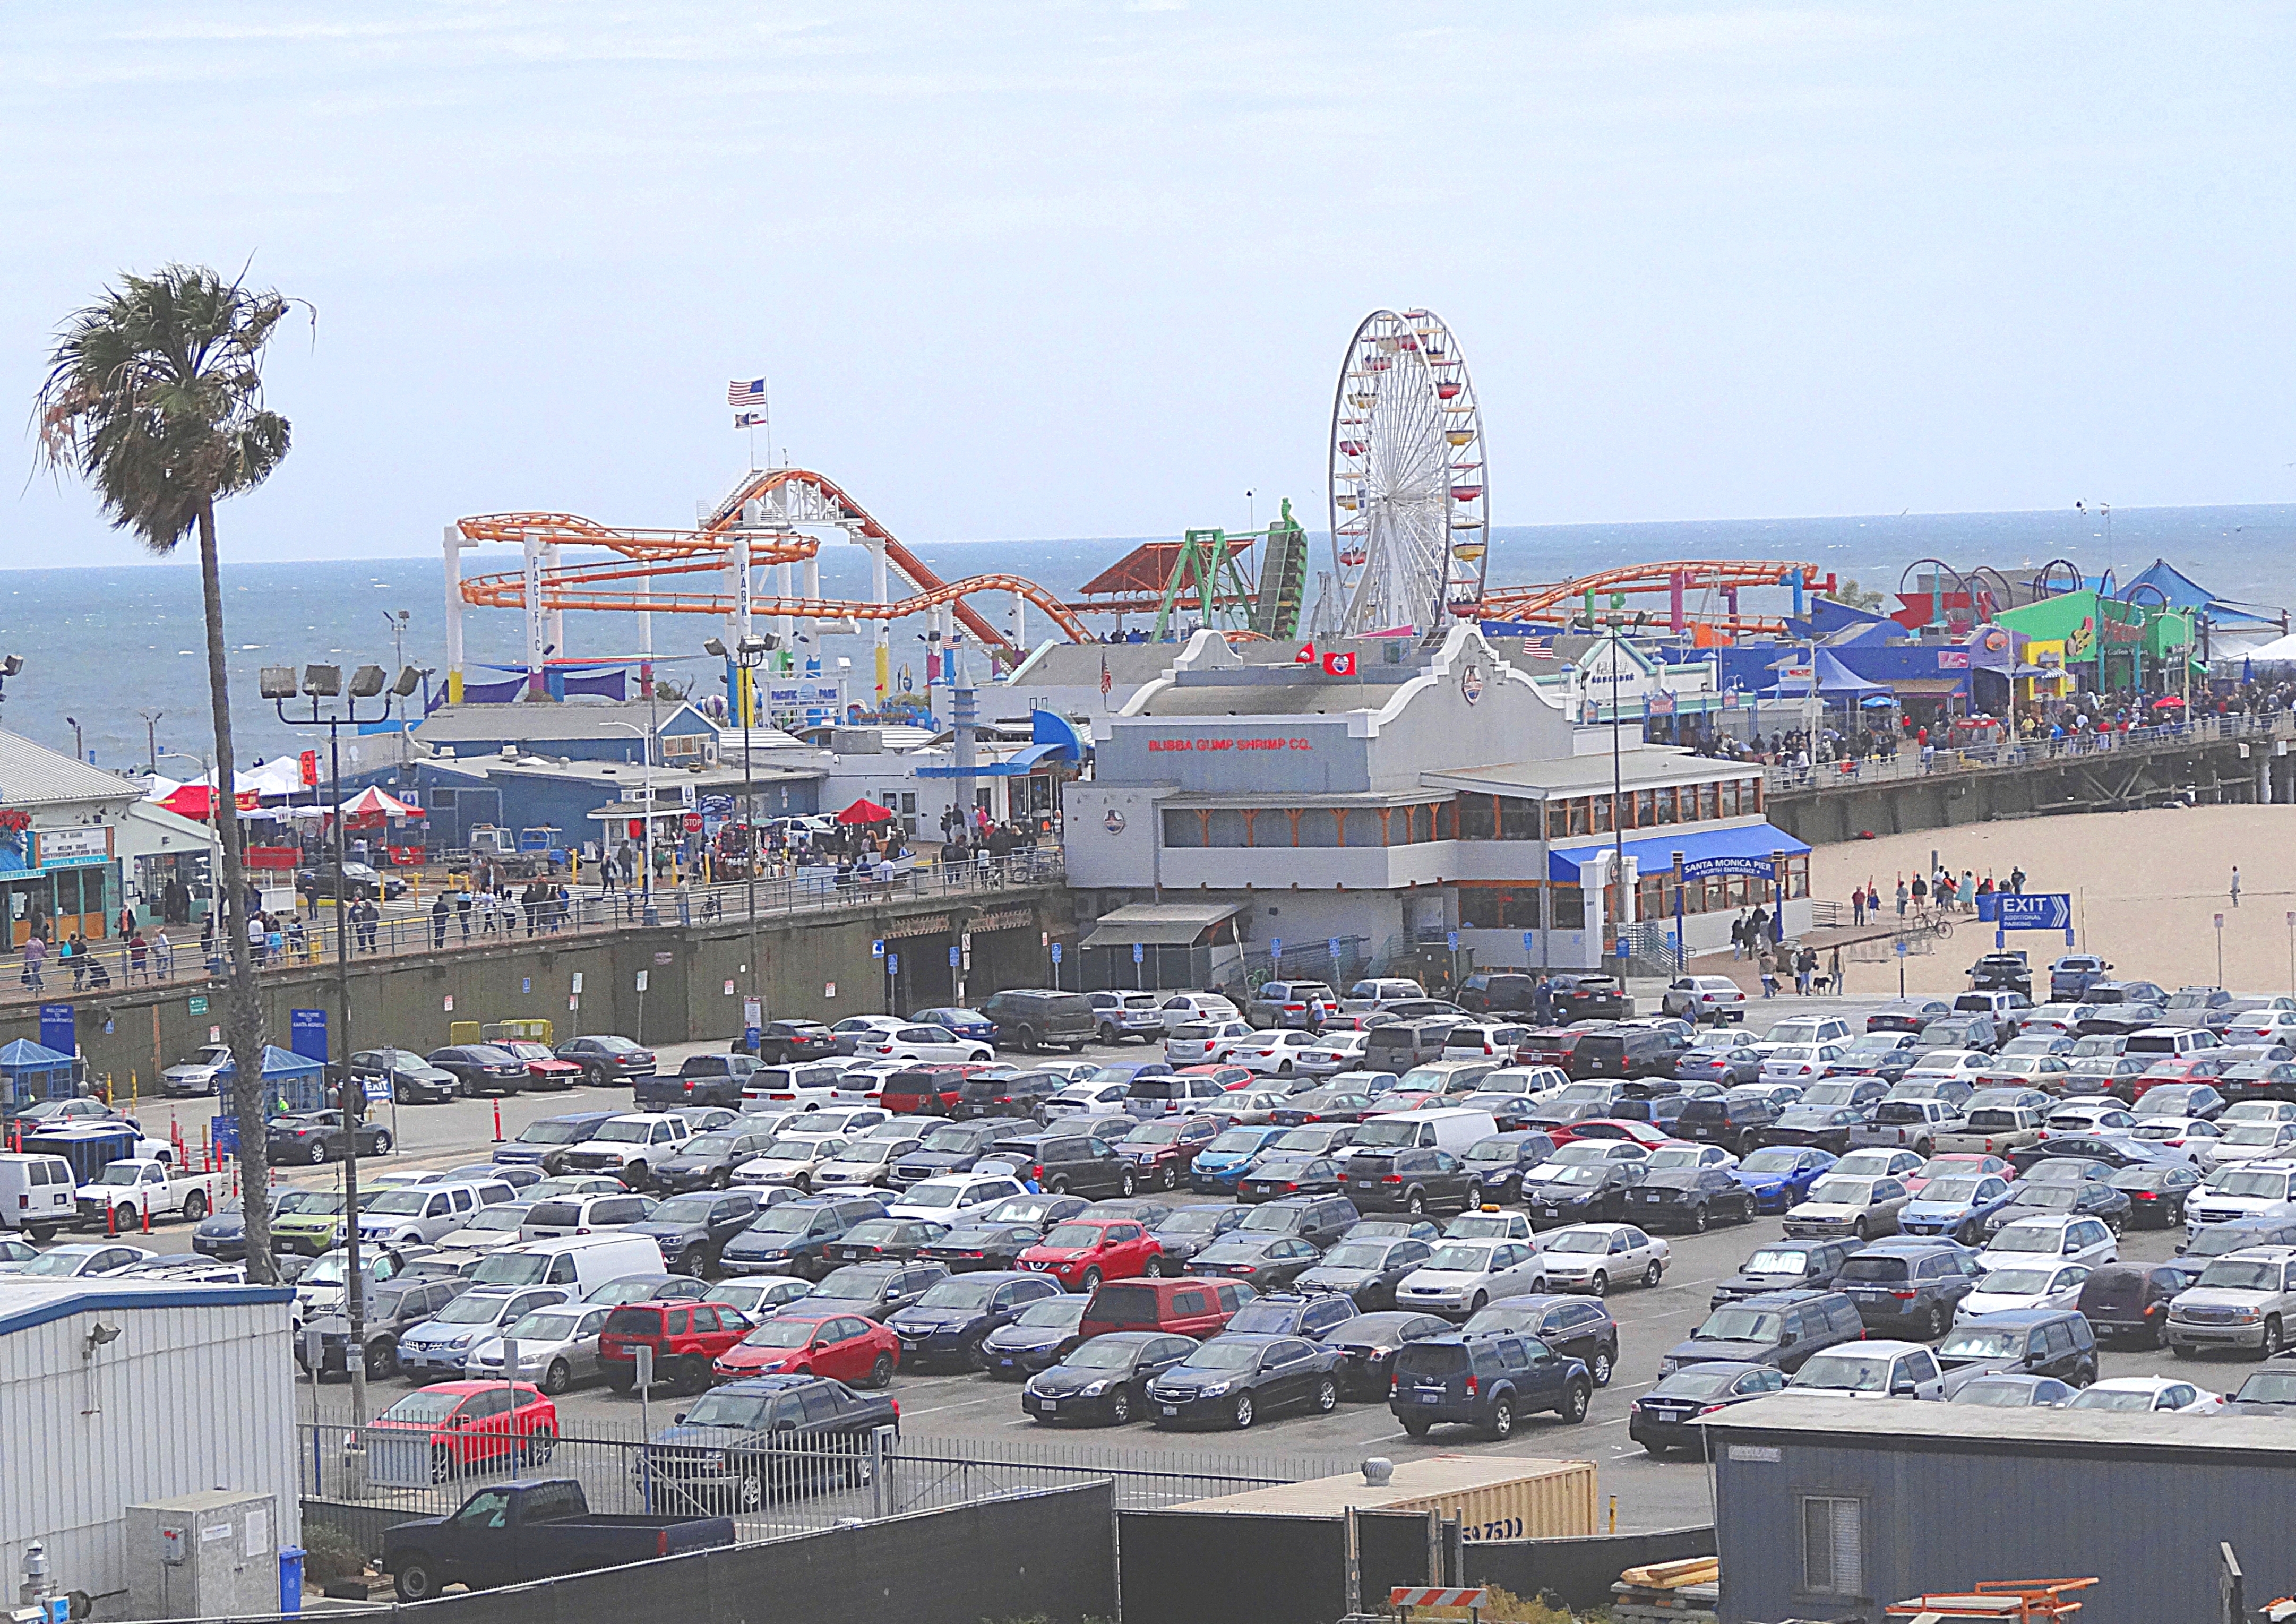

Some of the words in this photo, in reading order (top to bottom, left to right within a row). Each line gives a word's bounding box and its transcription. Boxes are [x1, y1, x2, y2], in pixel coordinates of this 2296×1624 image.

[771, 690, 797, 700] PACIFIC
[819, 688, 837, 699] PARK
[1148, 740, 1193, 752] BUBBA
[1197, 738, 1233, 751] GUMP
[1237, 738, 1286, 751] SHRIMP
[1288, 738, 1313, 750] CO.
[304, 754, 313, 781] ATM
[1684, 861, 1713, 873] SANTA
[1754, 861, 1772, 871] PIER
[2003, 897, 2047, 912] EXIT
[364, 1080, 388, 1092] EXIT
